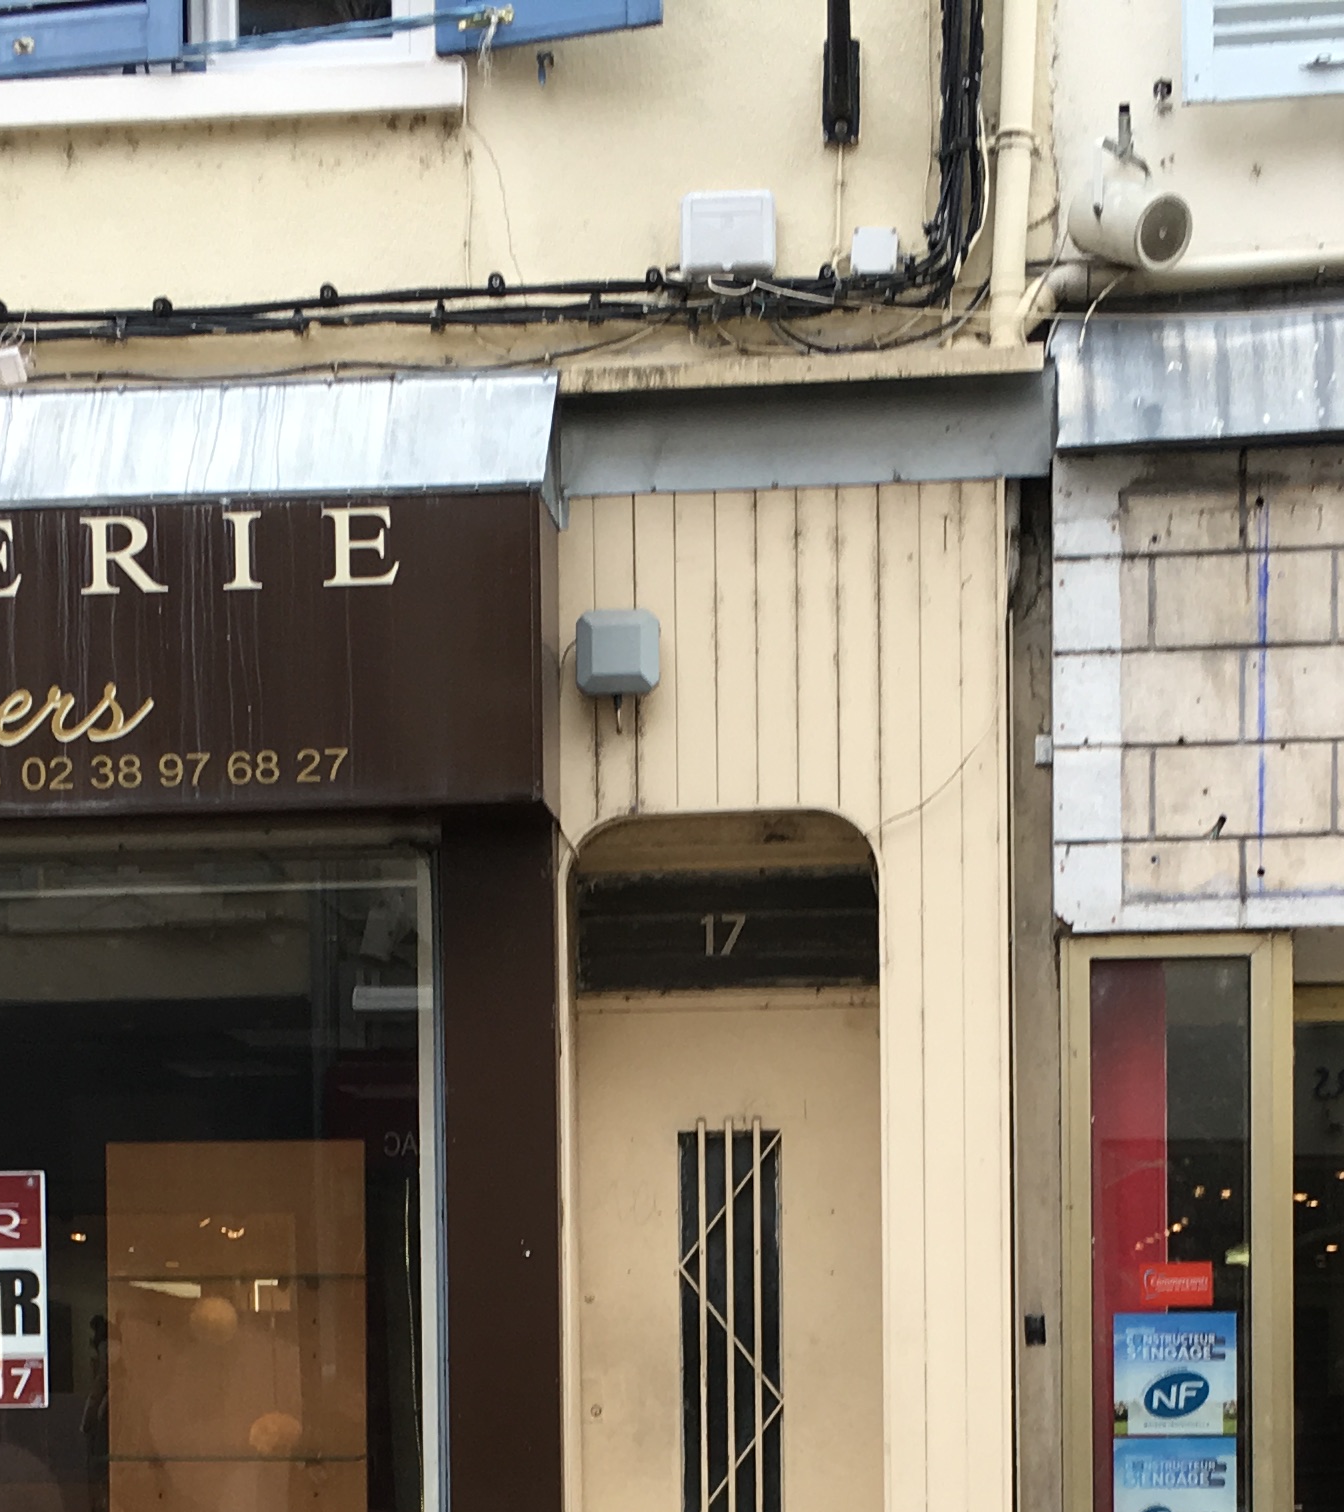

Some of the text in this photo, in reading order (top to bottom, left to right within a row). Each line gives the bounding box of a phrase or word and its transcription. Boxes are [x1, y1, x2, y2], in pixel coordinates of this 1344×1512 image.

[20, 747, 350, 792] 02 38 97 68 27
[700, 912, 747, 957] 17
[1152, 1380, 1205, 1410] NF
